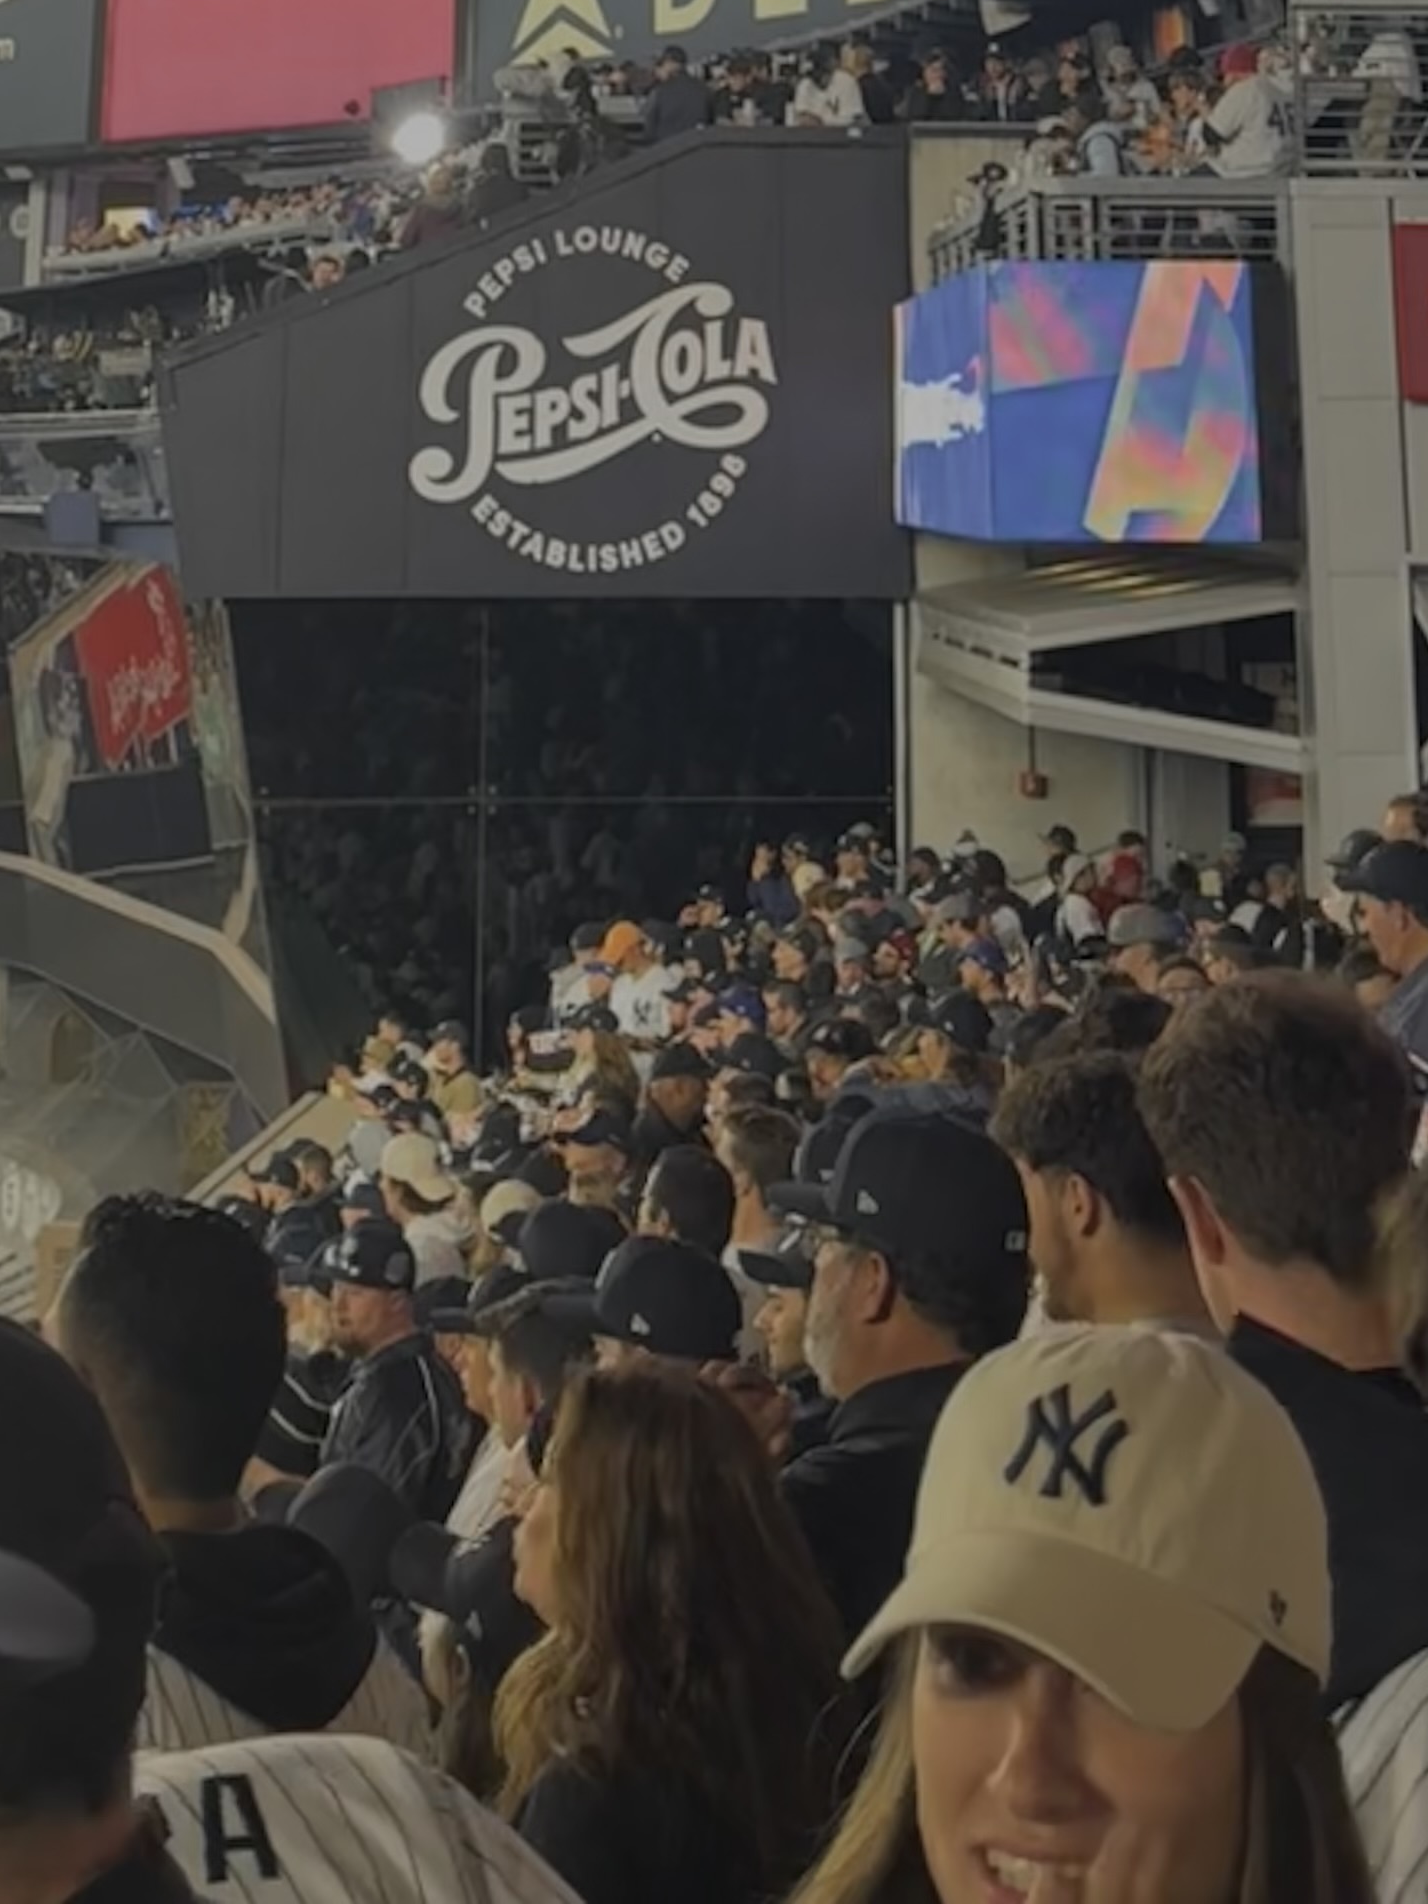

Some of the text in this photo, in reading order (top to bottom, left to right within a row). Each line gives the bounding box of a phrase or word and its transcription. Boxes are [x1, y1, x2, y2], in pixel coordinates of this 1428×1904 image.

[463, 225, 691, 319] PEPSI LOUNGE
[469, 452, 749, 573] ESTABLISHED 1898
